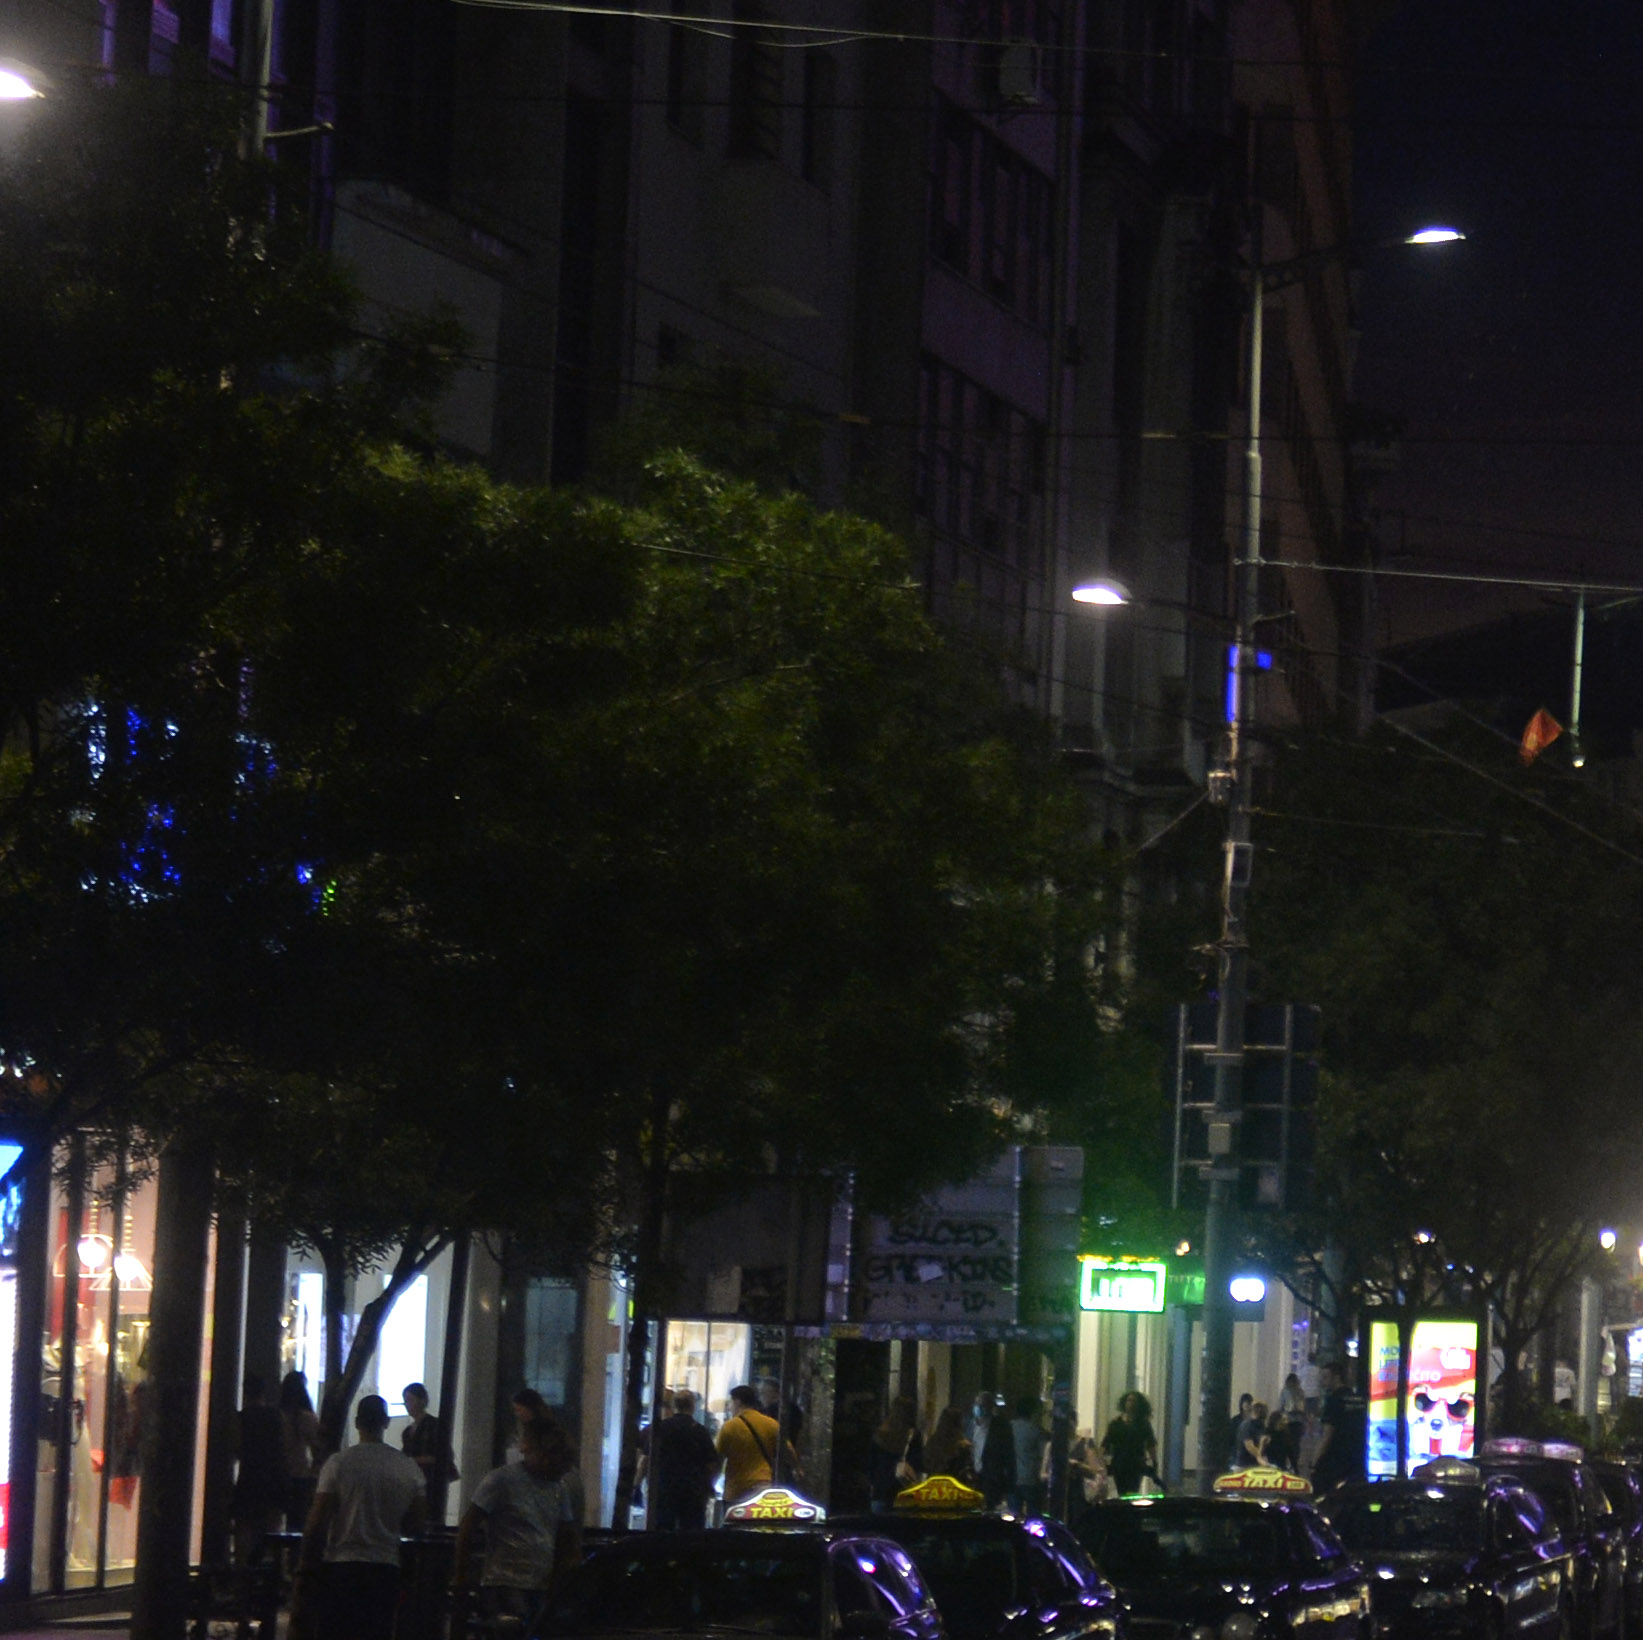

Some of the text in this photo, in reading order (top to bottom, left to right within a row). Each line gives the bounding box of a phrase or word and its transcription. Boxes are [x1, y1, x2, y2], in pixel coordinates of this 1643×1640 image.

[1243, 1477, 1284, 1489] TAXI
[919, 1487, 959, 1501] TAXI
[749, 1507, 794, 1519] TAXI
